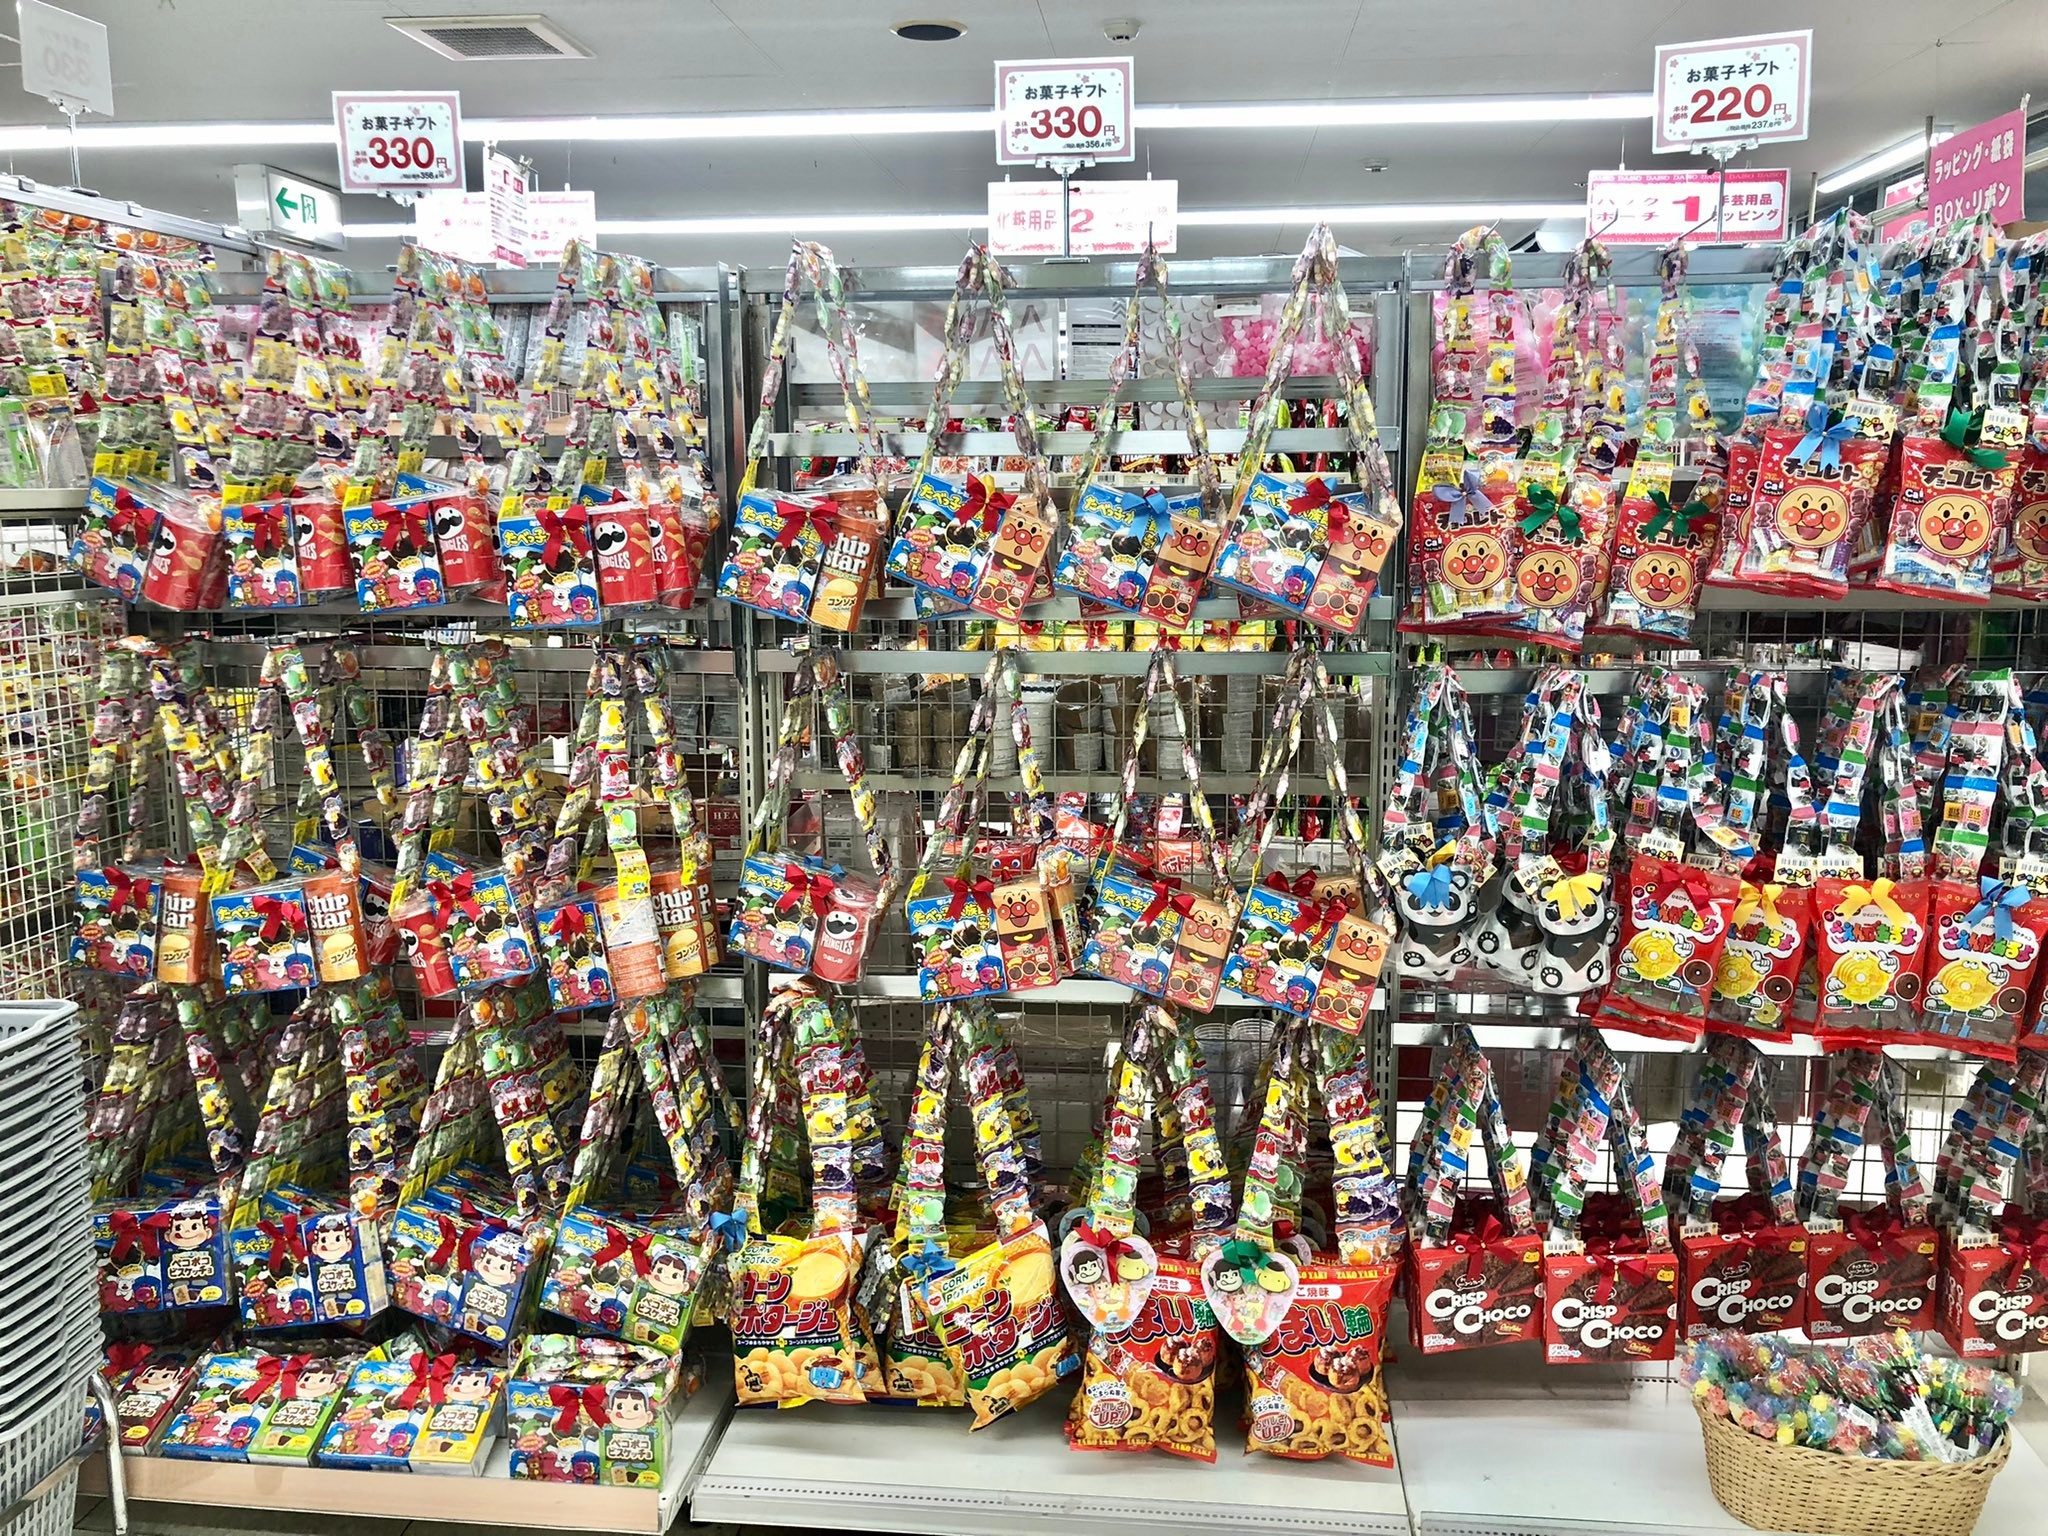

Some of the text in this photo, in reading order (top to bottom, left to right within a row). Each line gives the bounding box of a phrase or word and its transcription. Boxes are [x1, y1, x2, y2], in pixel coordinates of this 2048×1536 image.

[1686, 60, 1779, 84] お菓子ギフト
[1024, 83, 1107, 100] お菓子ギフト
[1690, 83, 1772, 124] 220
[1773, 103, 1788, 115] 円
[361, 115, 437, 131] お菓子ギフト
[1030, 105, 1103, 139] 330
[1103, 125, 1116, 136] 円
[368, 137, 435, 169] 330
[436, 157, 448, 168] 円
[1672, 196, 1700, 222] 1
[1934, 181, 2011, 228] BOX・リボン
[1069, 208, 1095, 234] 2
[503, 528, 550, 545] たべっ子
[827, 597, 857, 608] コンソメ
[307, 892, 350, 914] chip
[310, 908, 352, 930] star
[656, 904, 696, 927] star
[675, 942, 701, 961] コンソメ
[821, 931, 855, 955] PRINGLES
[163, 951, 191, 962] コンソメ
[330, 944, 357, 965] コンソメ
[743, 1270, 791, 1302] コーン
[942, 1271, 970, 1292] CORN
[1296, 1287, 1330, 1298] こ焼味
[735, 1301, 840, 1335] ポタージュ
[942, 1288, 1011, 1345] コーン
[962, 1297, 1068, 1372] ポタージュ
